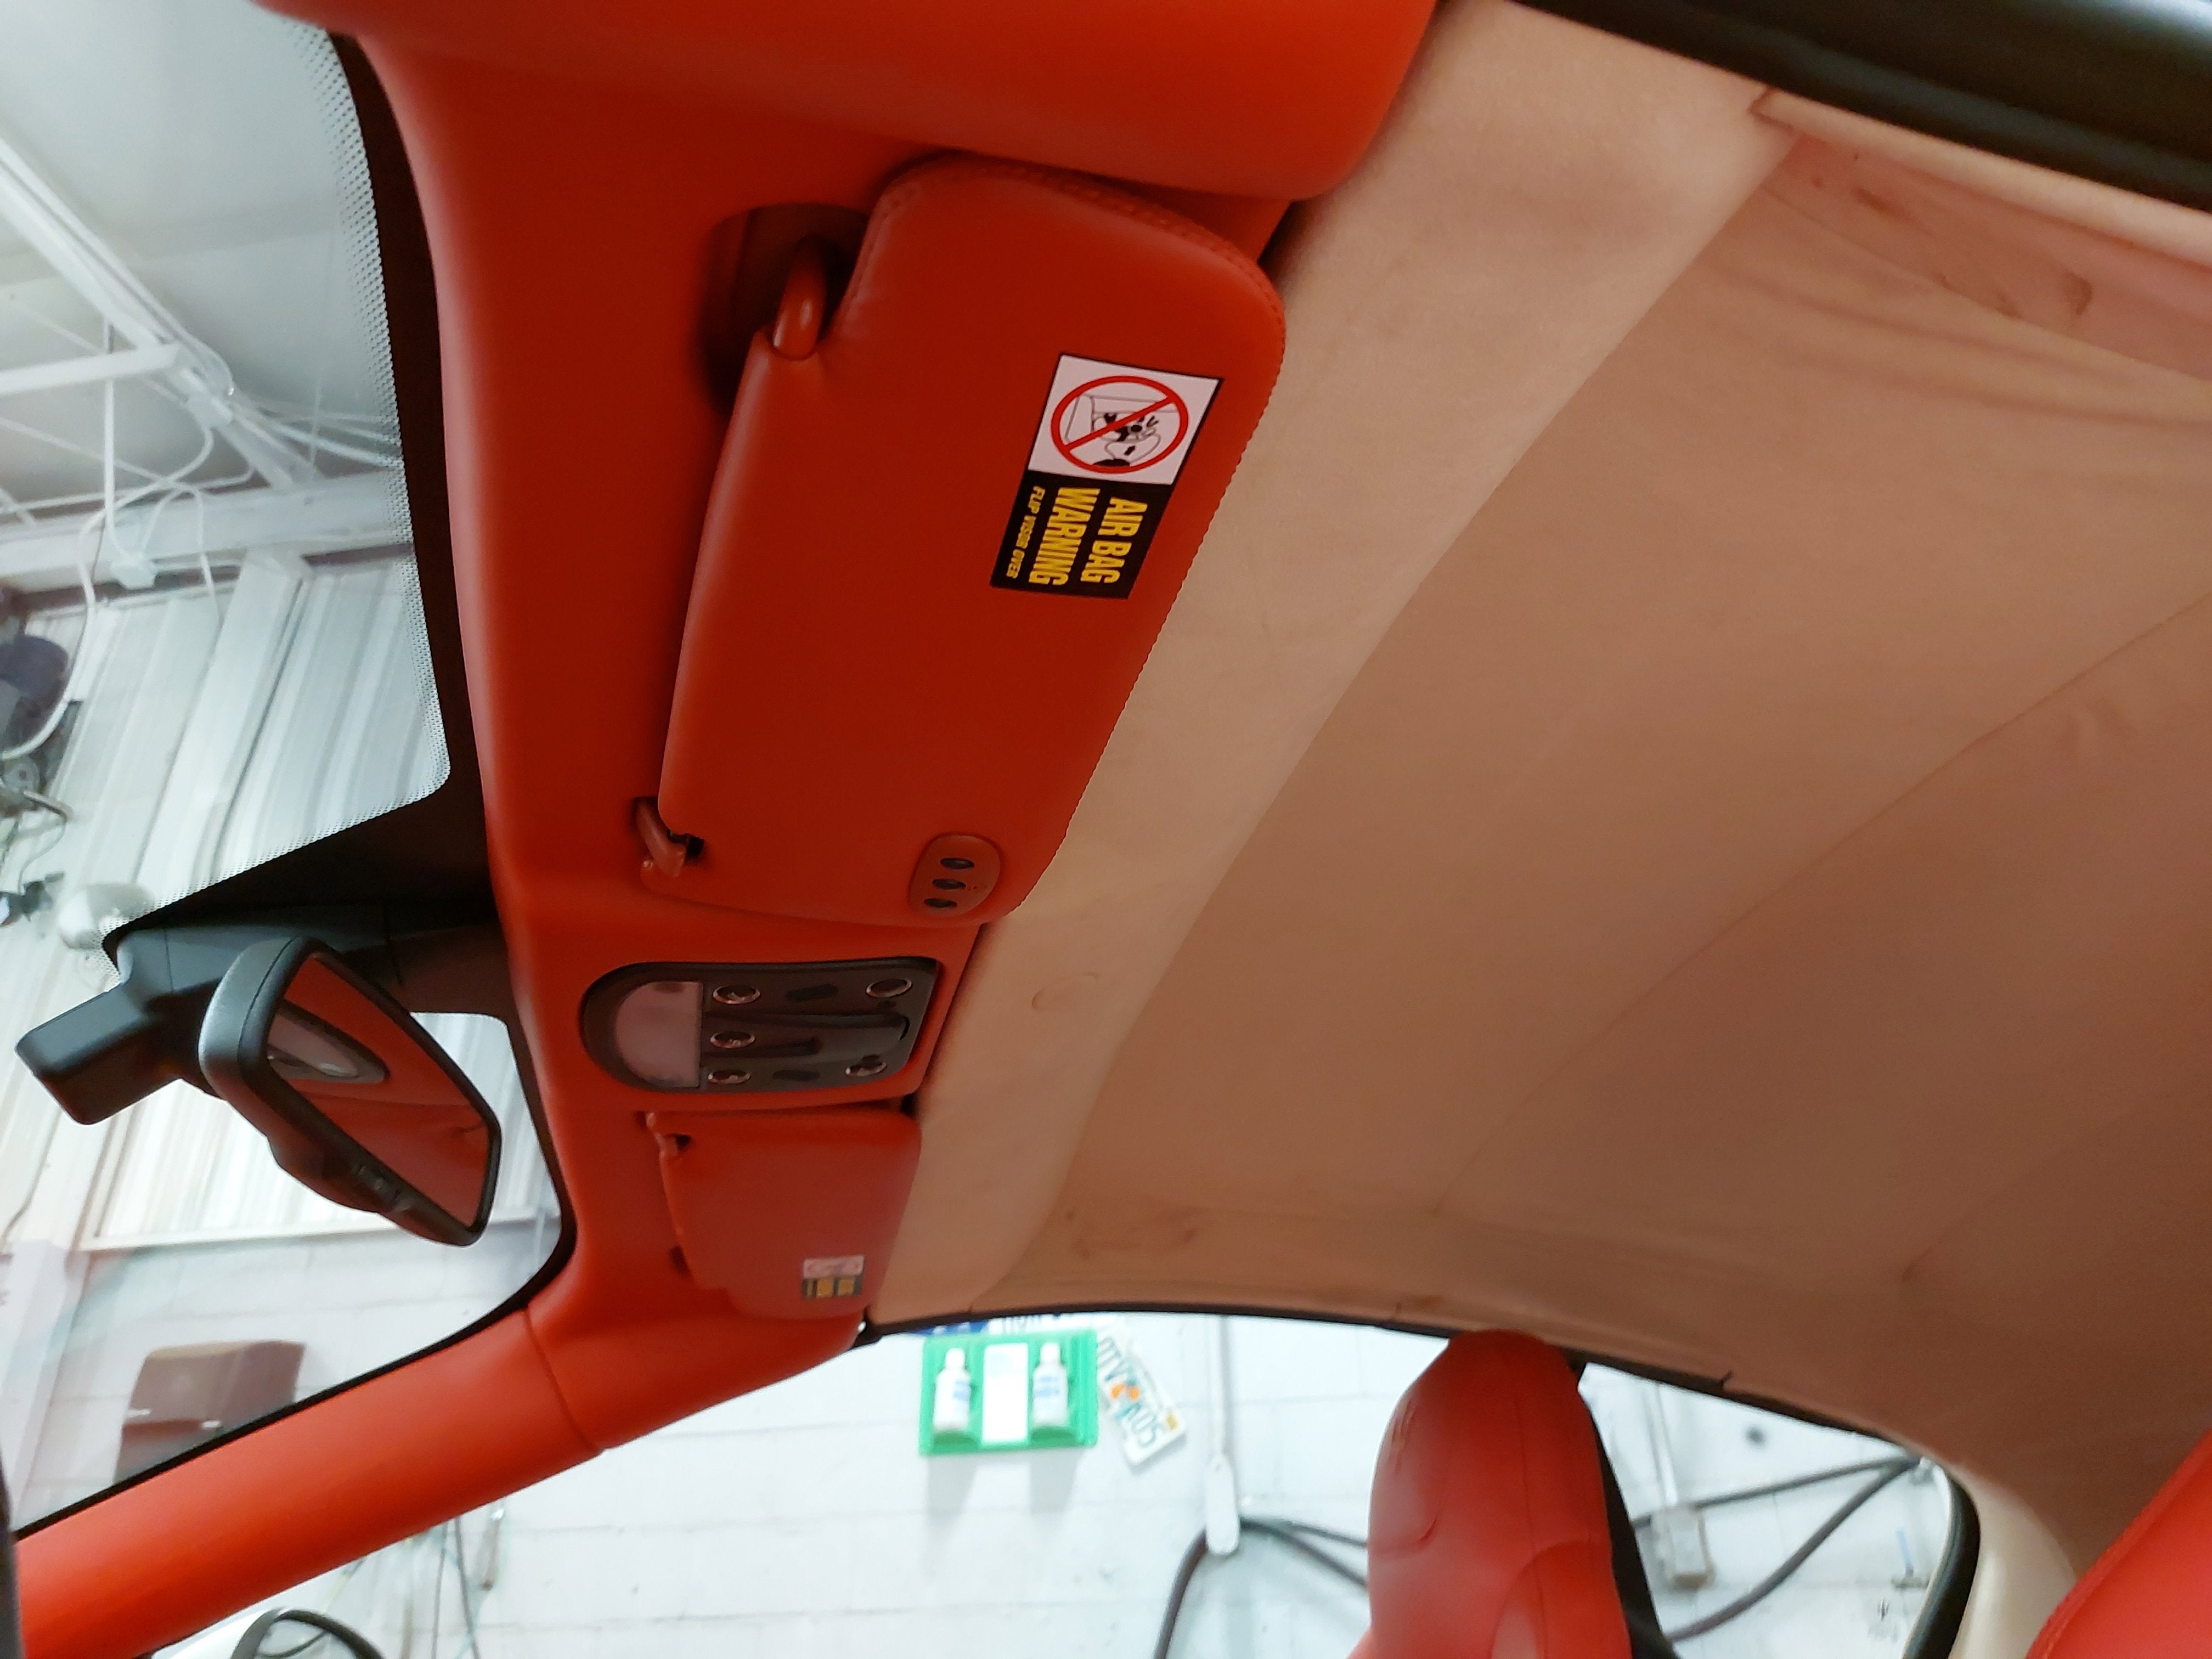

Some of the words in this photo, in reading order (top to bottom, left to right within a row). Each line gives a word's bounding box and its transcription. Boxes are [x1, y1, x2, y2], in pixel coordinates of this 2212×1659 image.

[1028, 486, 1045, 514] FLIP
[1098, 496, 1148, 537] AIR
[1016, 515, 1036, 549] VISOR
[1029, 487, 1101, 585] WARNING
[1006, 549, 1025, 579] OVER
[1080, 540, 1132, 583] BAG
